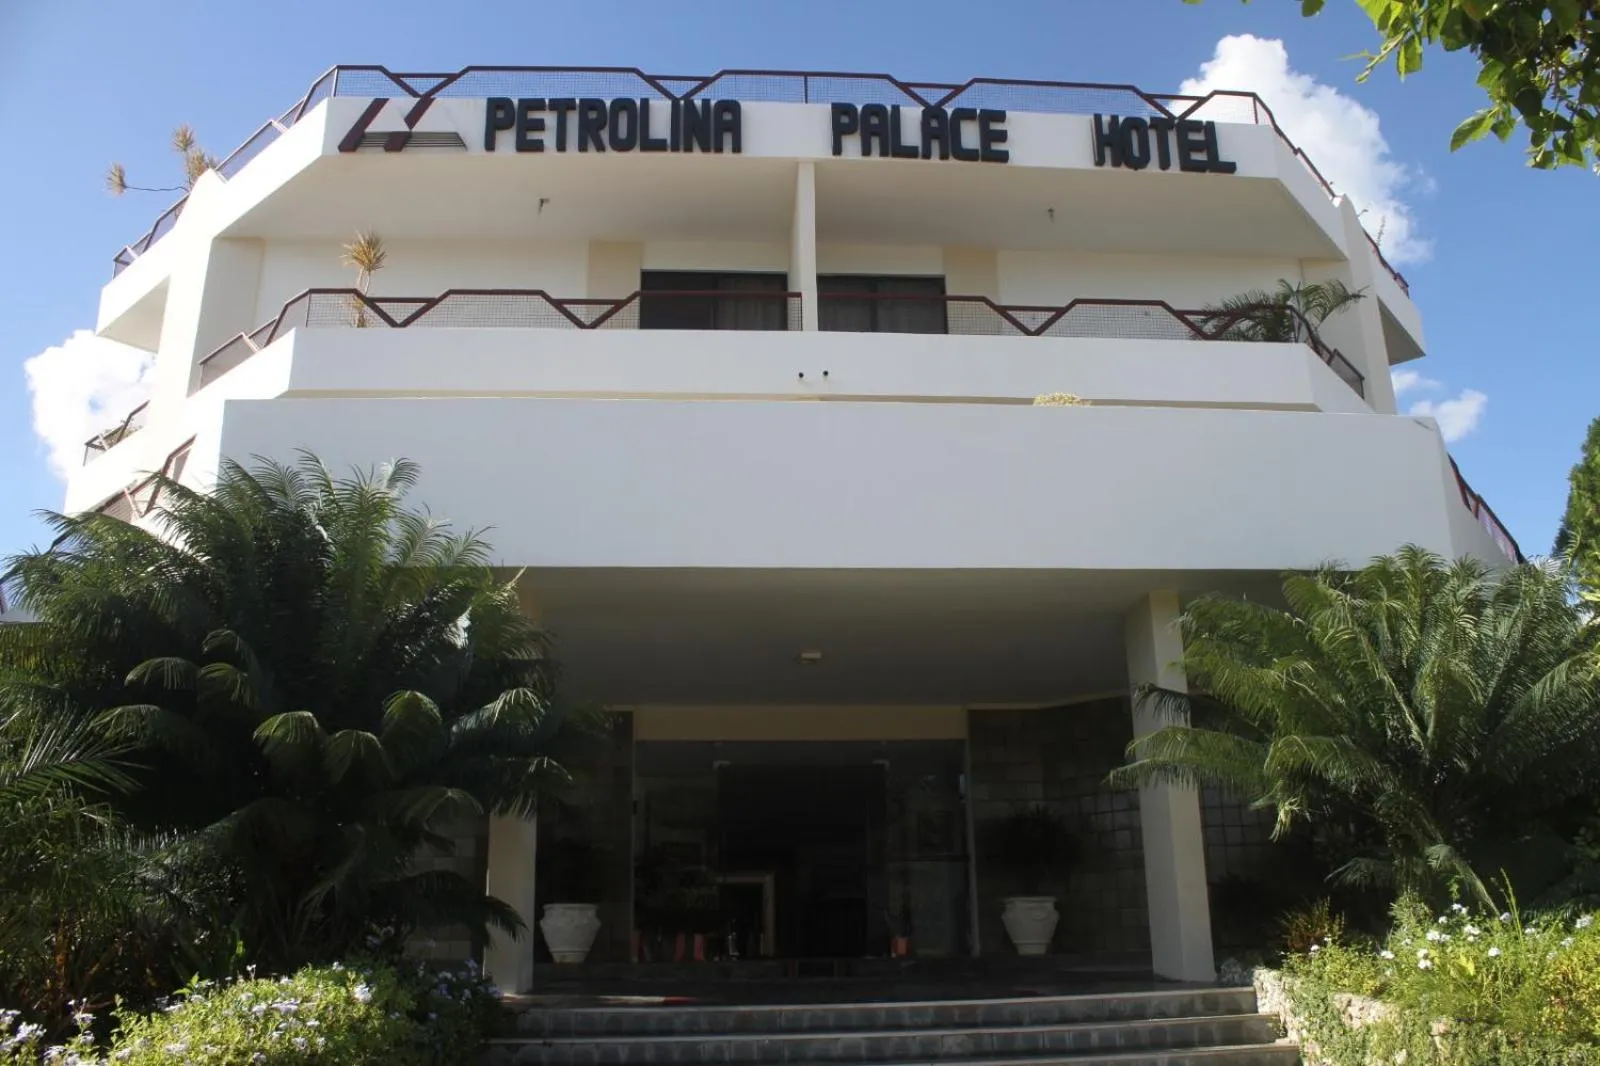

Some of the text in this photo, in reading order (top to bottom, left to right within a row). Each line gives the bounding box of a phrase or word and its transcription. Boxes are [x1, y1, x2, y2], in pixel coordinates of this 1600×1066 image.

[484, 97, 1236, 174] PETROLINA PALACE HOTEL
